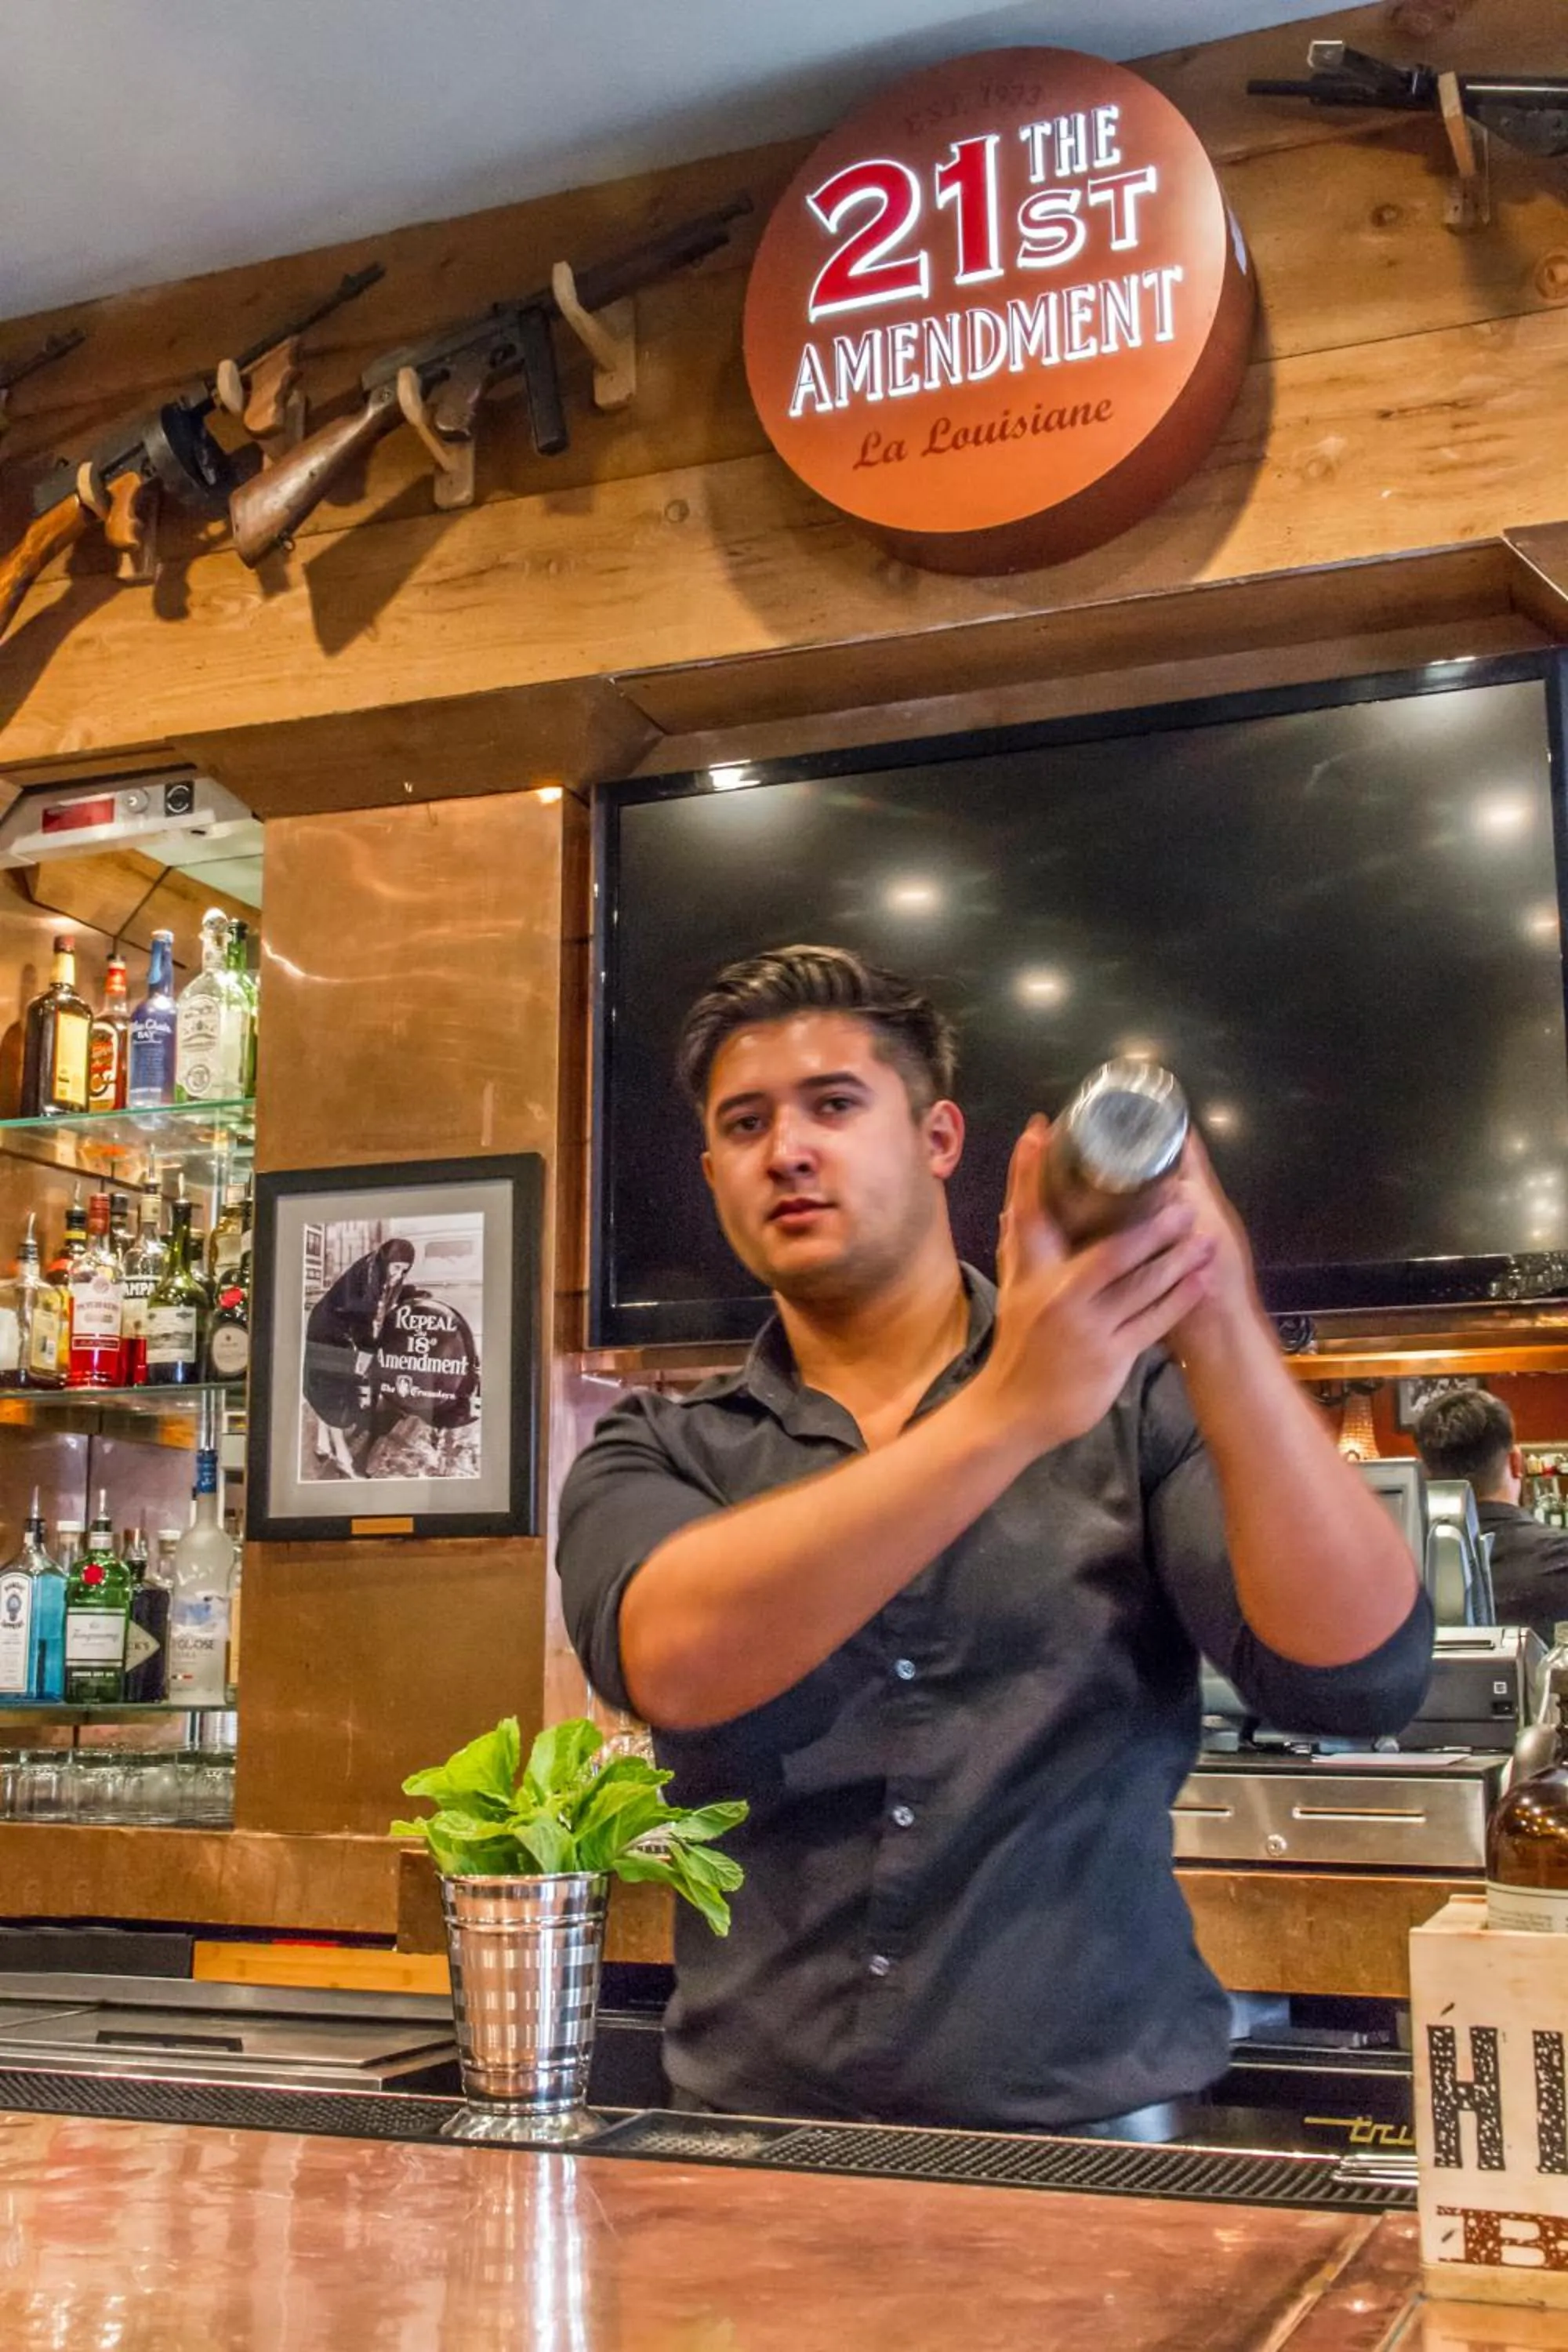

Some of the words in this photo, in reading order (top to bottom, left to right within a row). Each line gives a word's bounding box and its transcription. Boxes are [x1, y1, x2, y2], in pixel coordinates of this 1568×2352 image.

[1020, 105, 1120, 183] THE
[789, 266, 1184, 417] AMENDMENT
[851, 431, 907, 470] La
[920, 398, 1113, 458] Louisiane
[396, 1305, 457, 1331] REPEAL
[378, 1348, 468, 1375] Amendment
